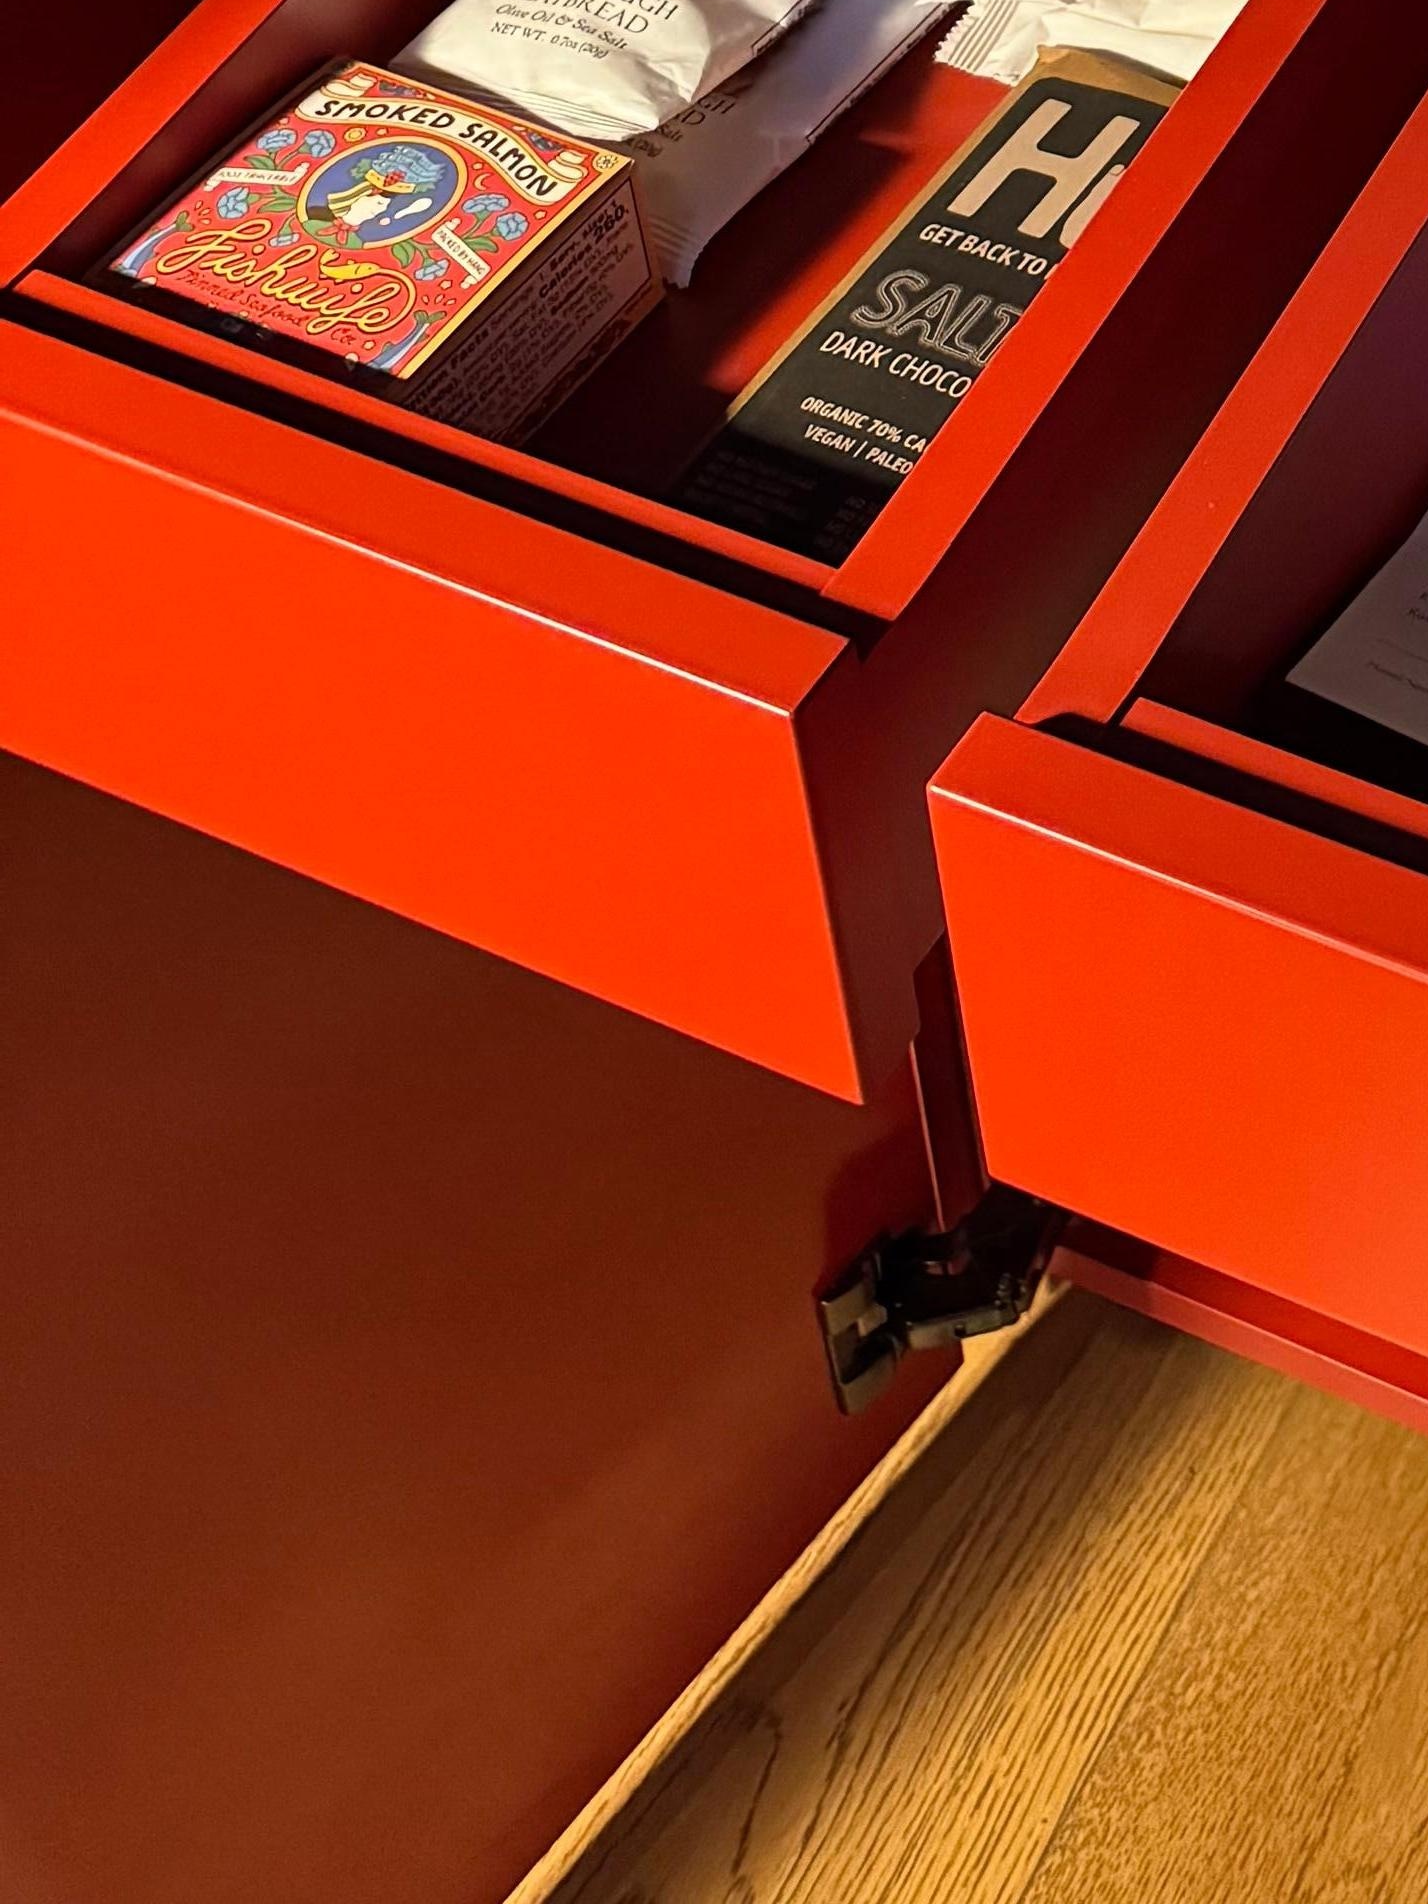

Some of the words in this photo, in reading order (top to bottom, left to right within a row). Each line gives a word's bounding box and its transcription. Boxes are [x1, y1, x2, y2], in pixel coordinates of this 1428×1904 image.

[491, 21, 521, 36] NET
[495, 3, 529, 21] Olive
[531, 8, 551, 24] Oil
[572, 17, 596, 36] Sea
[597, 29, 628, 50] Salt
[314, 98, 455, 131] SMOKED
[464, 122, 560, 198] SALMON
[156, 218, 417, 336] Fishwife
[918, 222, 962, 252] GET
[959, 233, 1016, 269] BACK
[1016, 252, 1049, 282] TO
[819, 329, 884, 371] DARK
[800, 395, 871, 432] ORGANIC
[869, 417, 903, 444] 70%
[803, 423, 858, 454] VEGAN
[864, 444, 914, 477] PALEO
